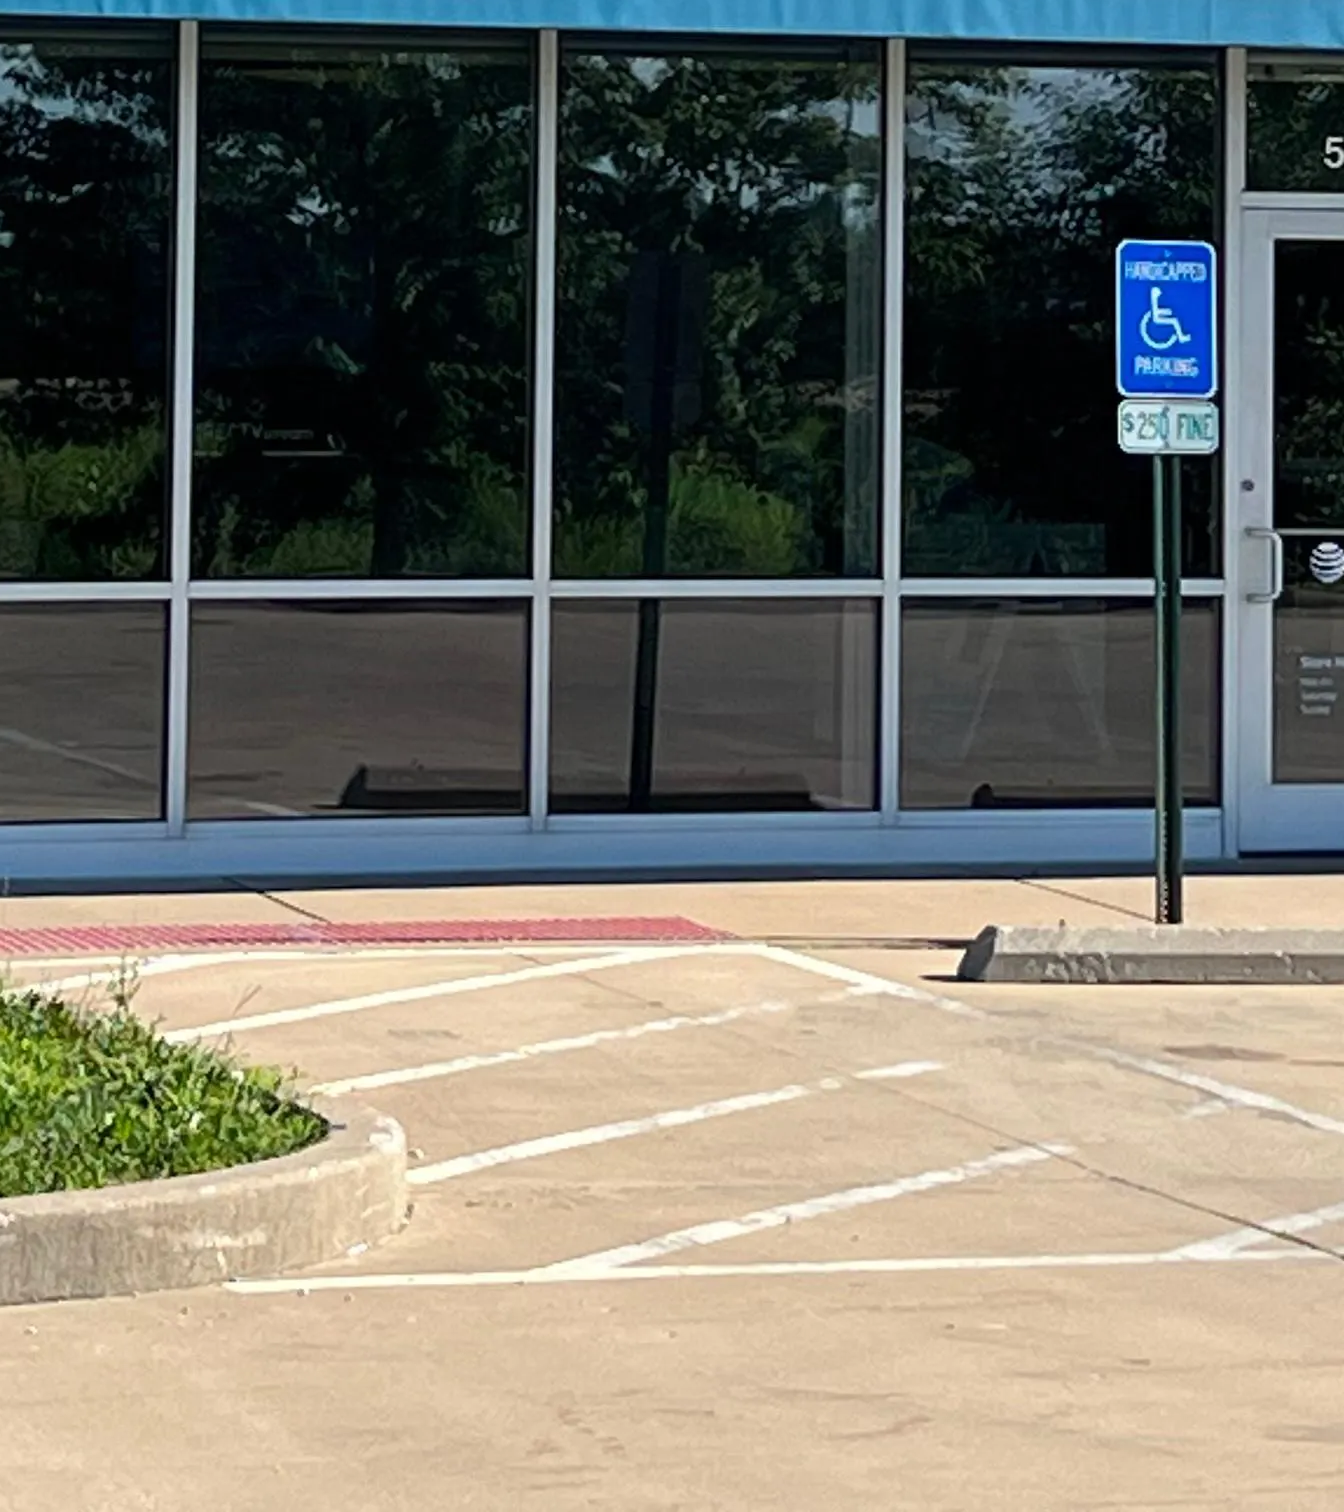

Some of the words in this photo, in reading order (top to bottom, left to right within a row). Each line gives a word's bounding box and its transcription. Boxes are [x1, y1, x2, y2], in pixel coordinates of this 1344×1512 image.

[1125, 260, 1207, 281] HANDICAPPED
[1133, 354, 1199, 378] PARKING
[1176, 412, 1215, 440] FINE
